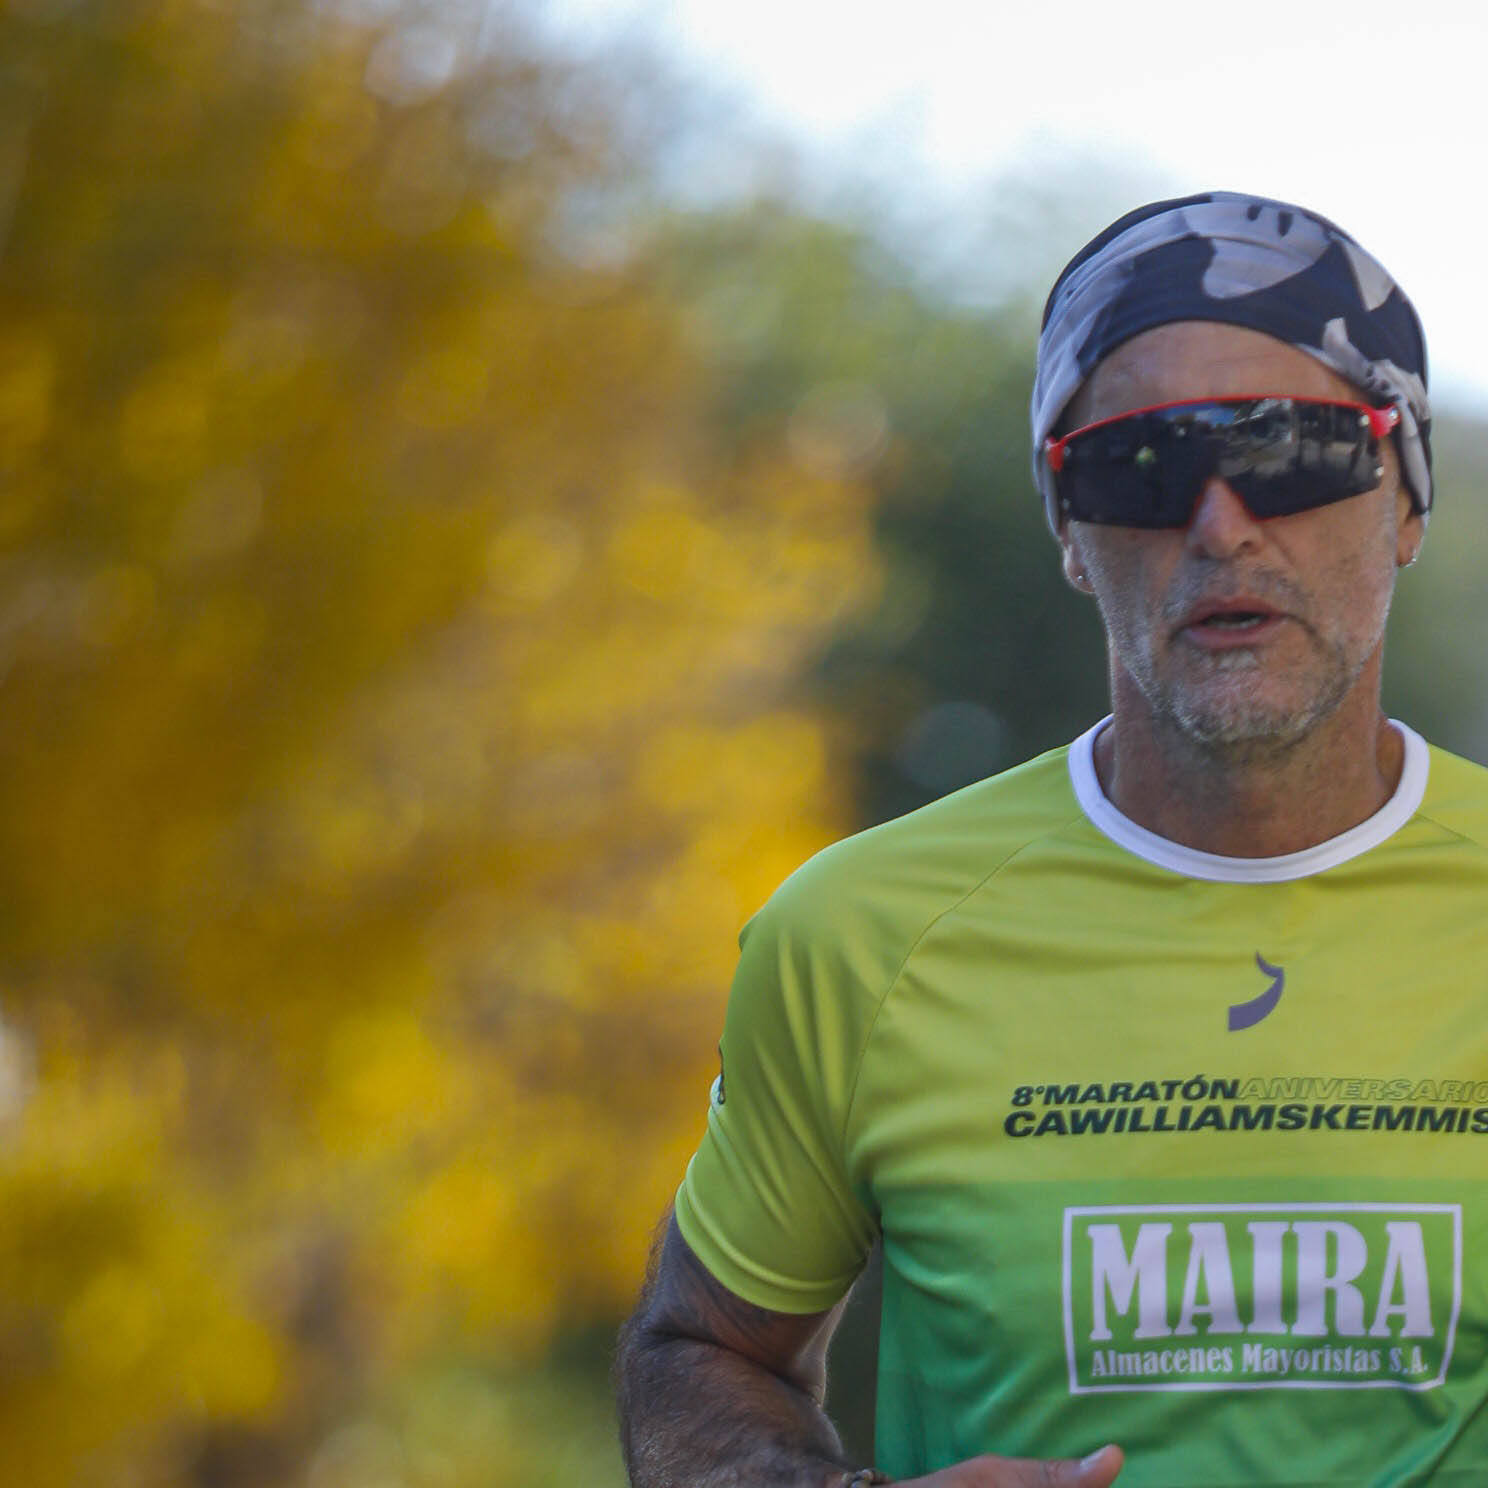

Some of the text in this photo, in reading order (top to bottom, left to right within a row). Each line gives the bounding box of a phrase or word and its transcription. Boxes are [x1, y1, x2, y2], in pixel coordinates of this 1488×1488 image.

[1088, 1221, 1434, 1340] MAIRA
[1091, 1346, 1233, 1377] Almacenes
[1241, 1343, 1381, 1375] Mayoristas
